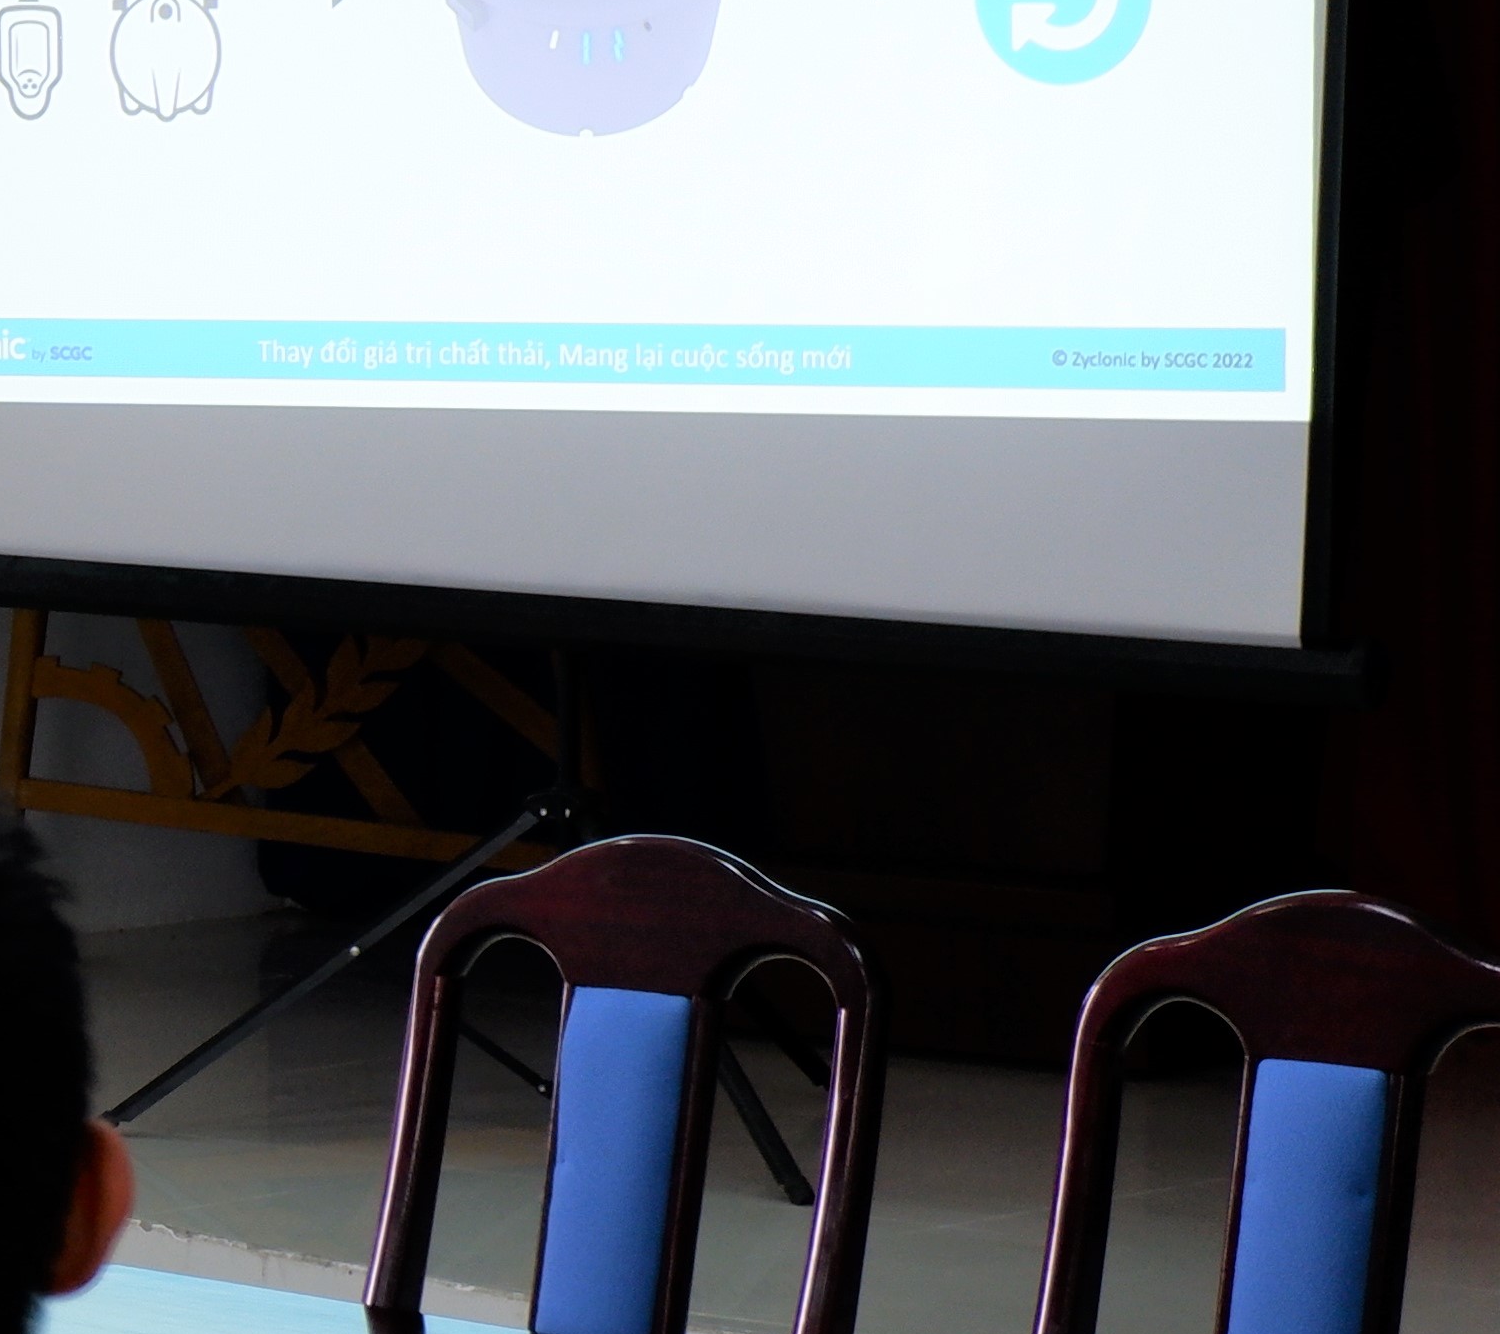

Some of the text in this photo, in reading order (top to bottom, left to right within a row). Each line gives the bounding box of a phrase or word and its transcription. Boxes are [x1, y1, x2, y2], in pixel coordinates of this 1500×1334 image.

[31, 348, 46, 363] by
[49, 346, 93, 361] SCGC
[257, 339, 314, 368] Thay
[363, 339, 398, 370] giá
[405, 342, 432, 367] trị
[438, 338, 490, 365] chất
[559, 343, 629, 373] Mang
[635, 343, 663, 372] lại
[669, 343, 729, 372] cuộc
[735, 341, 795, 375] sống
[801, 344, 851, 370] mới
[1071, 350, 1137, 369] Zyclonic
[1141, 351, 1160, 370] by
[1164, 352, 1208, 368] SCGC
[1212, 352, 1254, 369] 2022
